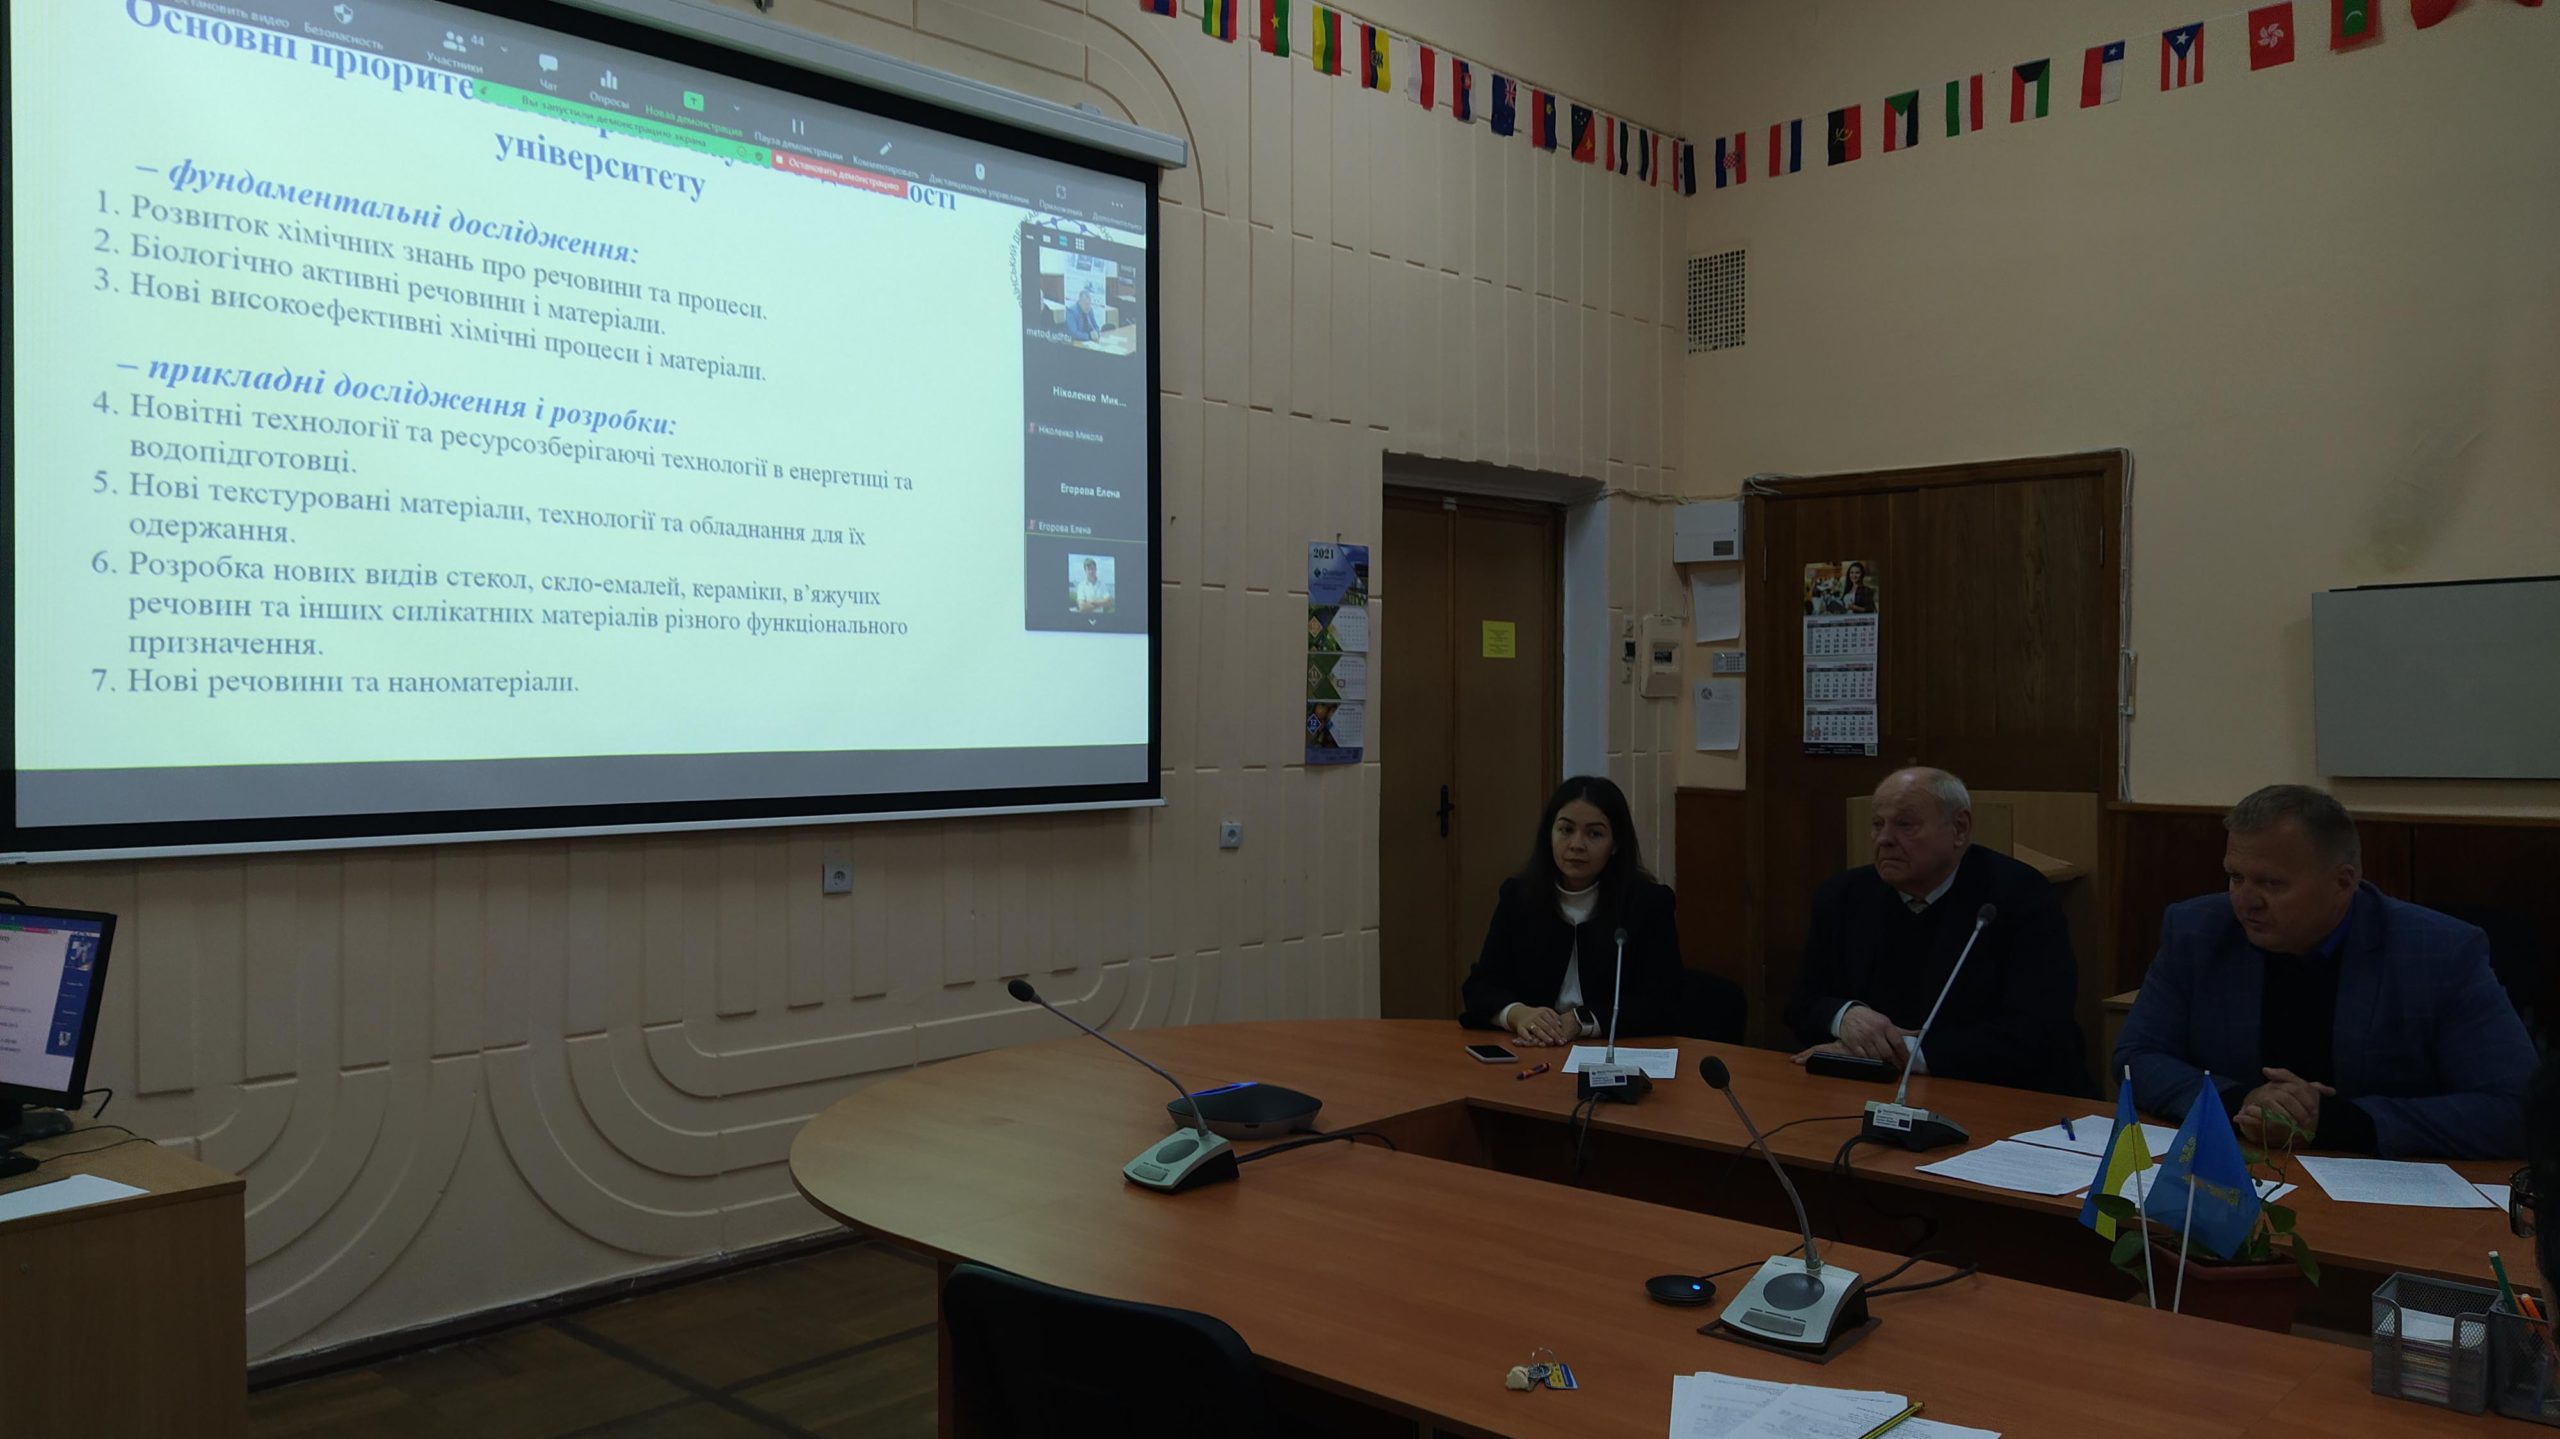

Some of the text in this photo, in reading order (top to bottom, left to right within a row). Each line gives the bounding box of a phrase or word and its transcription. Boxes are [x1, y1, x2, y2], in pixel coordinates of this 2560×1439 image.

[250, 13, 290, 29] видео
[126, 0, 474, 100] Основні пріорите
[304, 22, 383, 51] Безопасность
[426, 51, 483, 75] Участники
[540, 79, 557, 92] Чат
[590, 91, 629, 110] Опросы
[754, 131, 780, 146] Пауза
[495, 133, 705, 203] університету
[789, 157, 837, 177] Остановить
[168, 158, 442, 229] фундаментальні
[449, 209, 639, 264] дослідження:
[910, 183, 955, 211] ості
[99, 189, 766, 320] 1. Розвиток хімічних знань про речовини та процеси.
[94, 227, 665, 335] 2. Біологічно активні речовини і матеріали.
[94, 266, 765, 381] 3. Нові високоефективні хімічні процеси і матеріали.
[148, 360, 325, 395] прикладні
[333, 372, 526, 418] дослідження
[535, 396, 544, 420] і
[548, 406, 676, 435] розробки:
[1053, 385, 1095, 402] Ніколенко
[92, 390, 913, 490] 4. Новітні технології та ресурсозберігаючі технології в енергетиці та
[130, 439, 356, 474] водопідготовці.
[1060, 482, 1120, 498] Егорова Елена
[93, 469, 865, 546] 5. Нові текстуровані матеріали, технології та обладнання для їх
[129, 517, 295, 544] одержання.
[1038, 521, 1091, 534] Егорова Елена
[1313, 548, 1334, 559] 2021
[91, 550, 116, 574] 6.
[129, 551, 264, 583] Розробка
[274, 563, 356, 584] нових
[366, 563, 438, 588] видів
[446, 570, 534, 592] стекол,
[541, 575, 685, 599] скло-емалей,
[692, 580, 787, 603] кераміки,
[129, 595, 908, 635] речовин та інших силікатних матеріалів різного функціонального
[129, 635, 323, 659] призначення.
[91, 667, 578, 698] 7. Нові речовини та наноматеріали.
